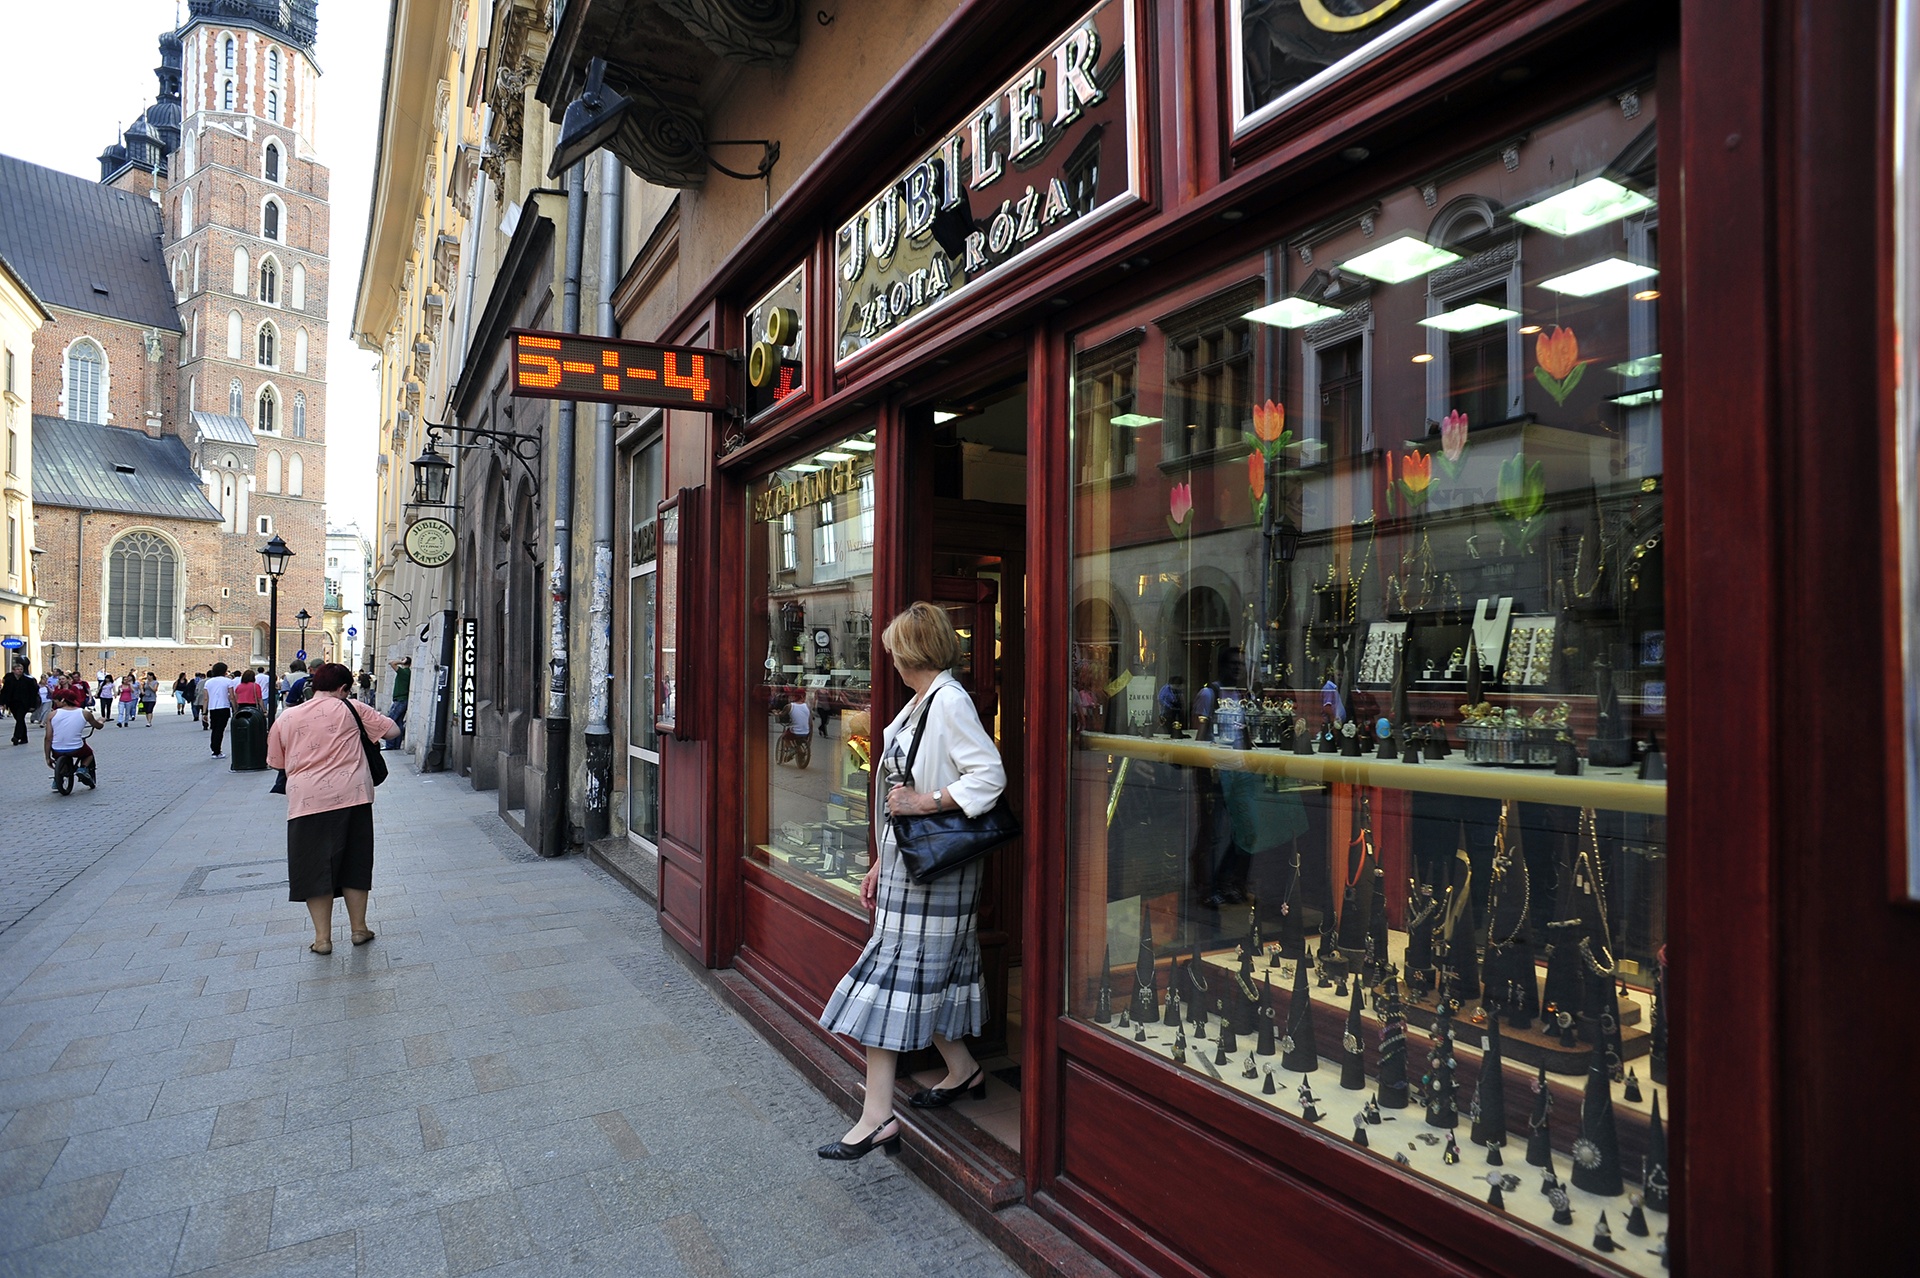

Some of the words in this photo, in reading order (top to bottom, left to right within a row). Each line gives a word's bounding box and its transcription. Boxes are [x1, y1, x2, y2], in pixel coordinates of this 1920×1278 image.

[843, 27, 1106, 282] JUBILER
[860, 256, 950, 338] ZŁOTA
[964, 178, 1071, 273] RÓŻA
[412, 521, 450, 536] JUBILER
[755, 455, 861, 523] EXCHANGE
[413, 551, 450, 564] KANTOR
[464, 622, 475, 732] EXCHANGE
